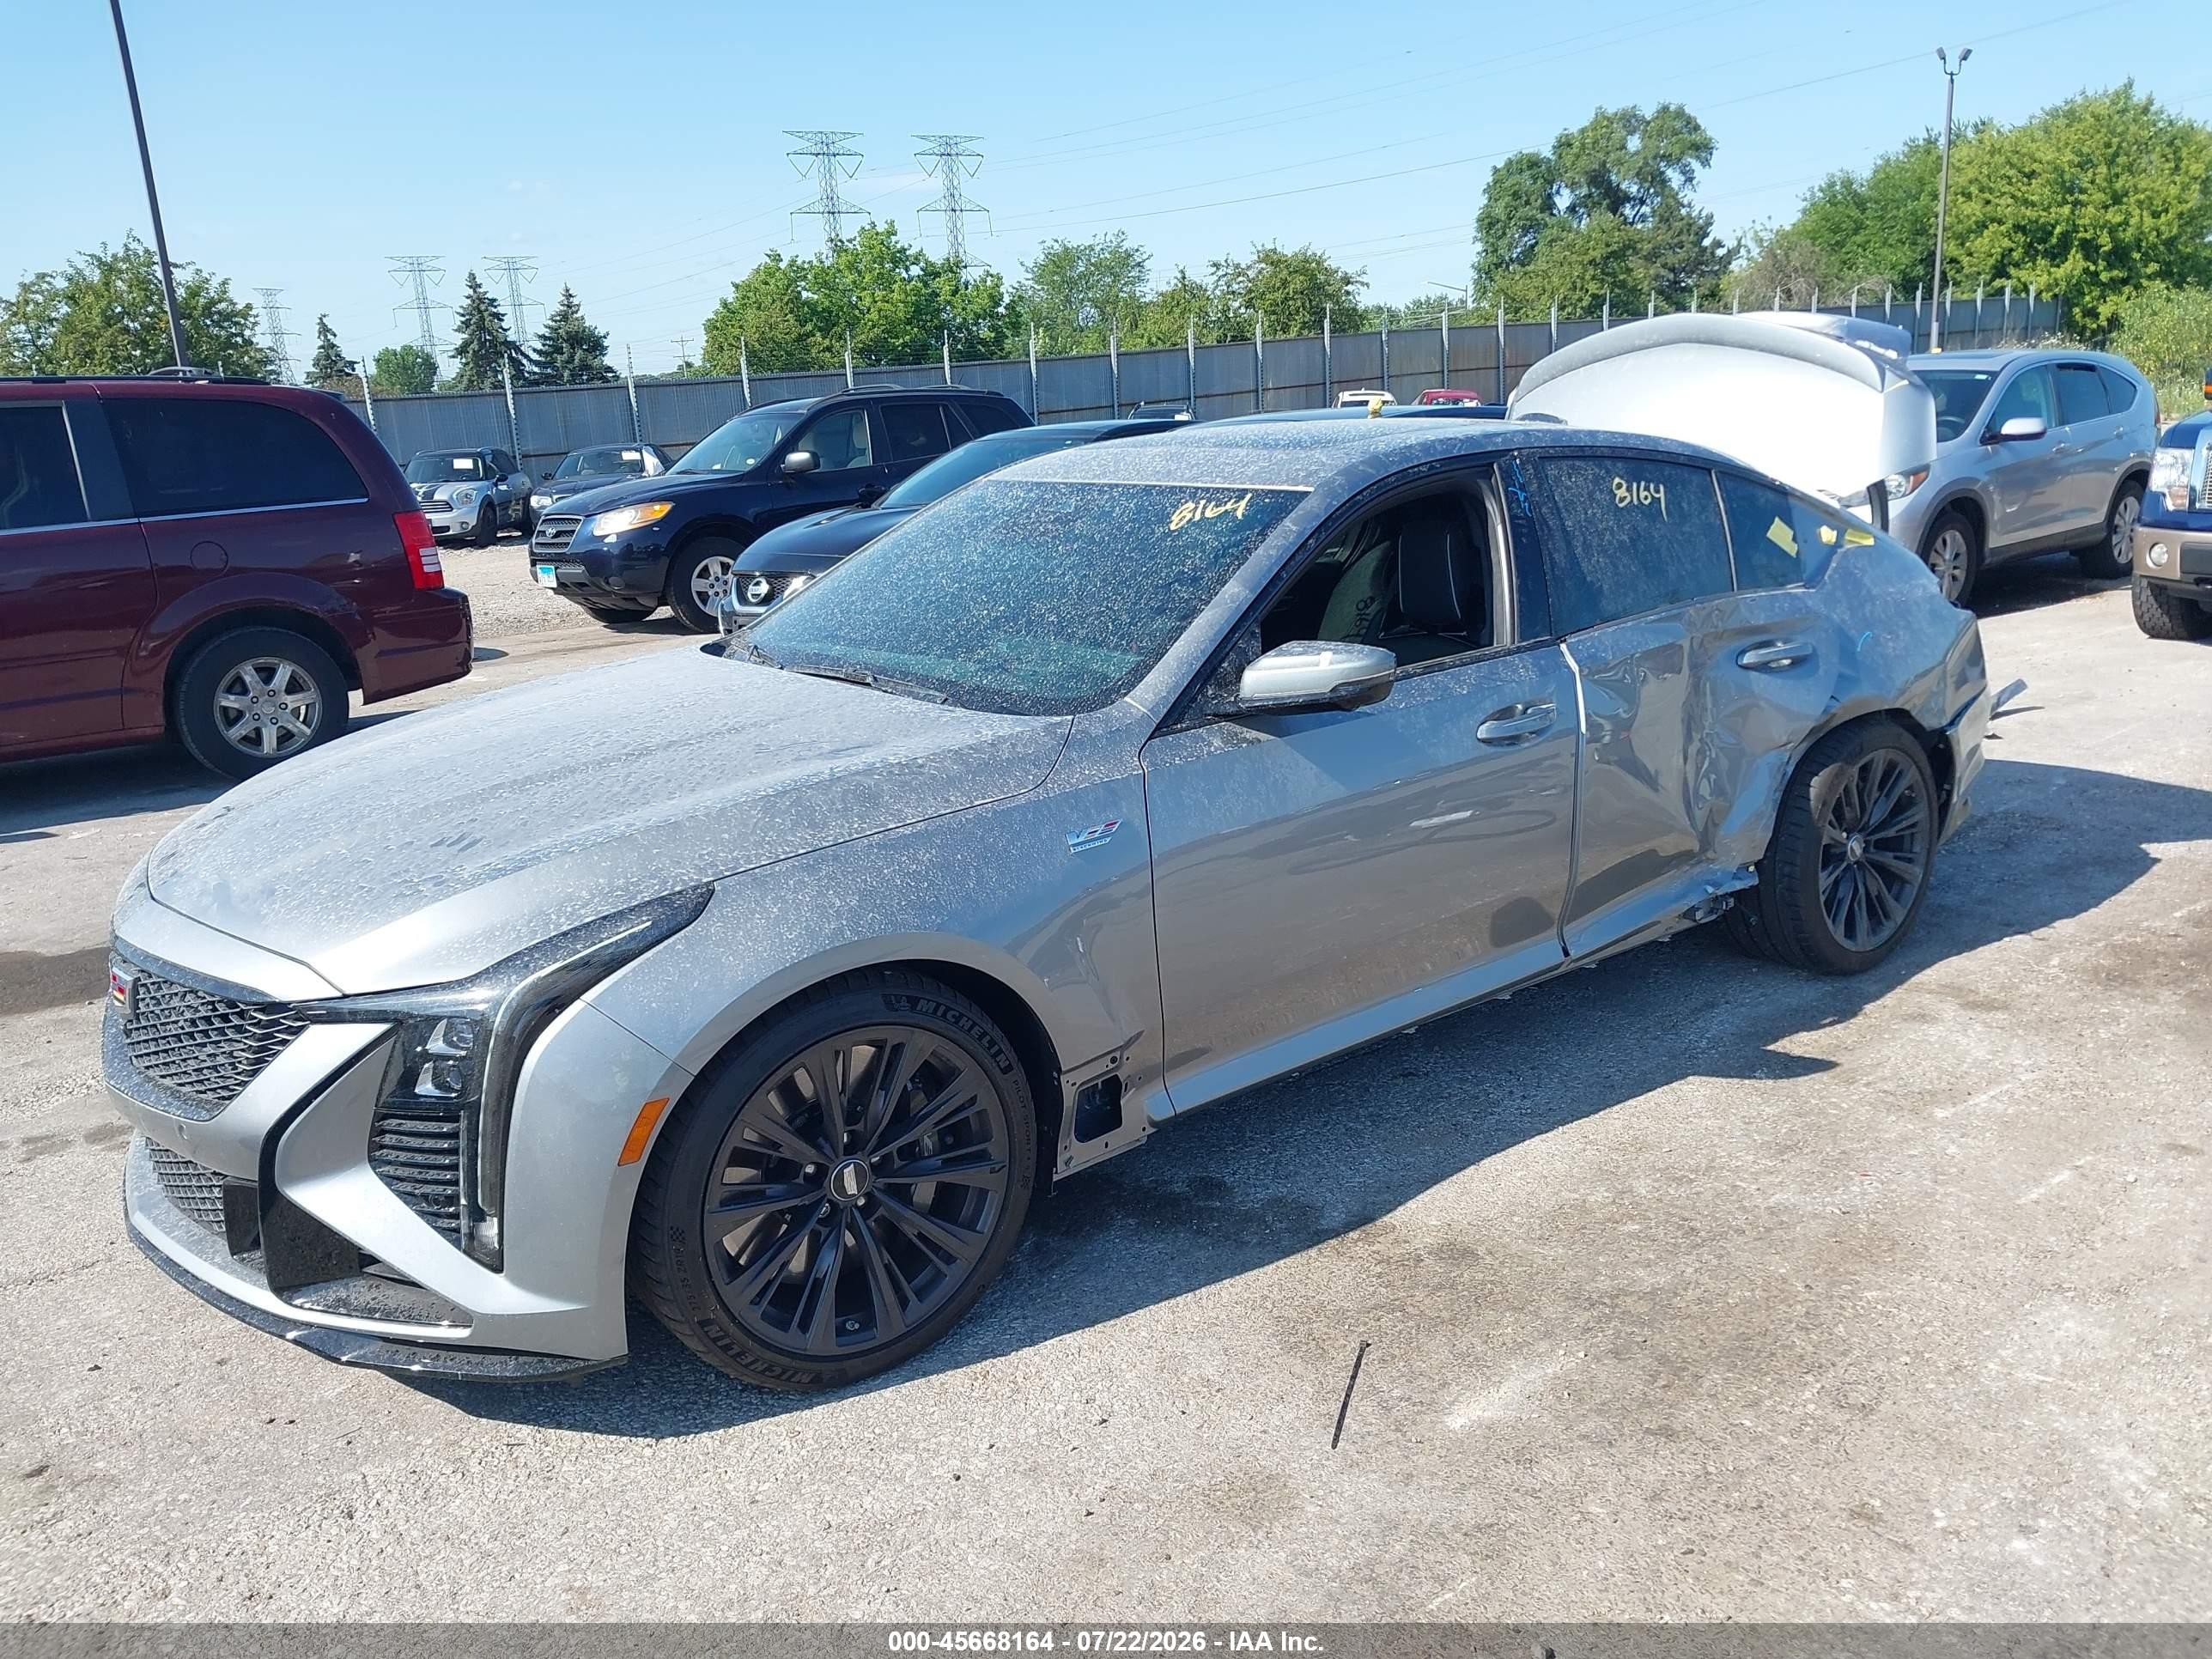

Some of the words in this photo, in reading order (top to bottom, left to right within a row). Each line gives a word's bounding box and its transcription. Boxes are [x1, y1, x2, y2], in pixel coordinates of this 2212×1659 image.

[1170, 494, 1253, 531] 8164
[1613, 477, 1668, 522] 8164
[915, 997, 1011, 1069] MICHELIN
[1012, 1079, 1026, 1109] PILOT
[1023, 1115, 1031, 1152] SPORT
[703, 1324, 815, 1383] MICHELIN
